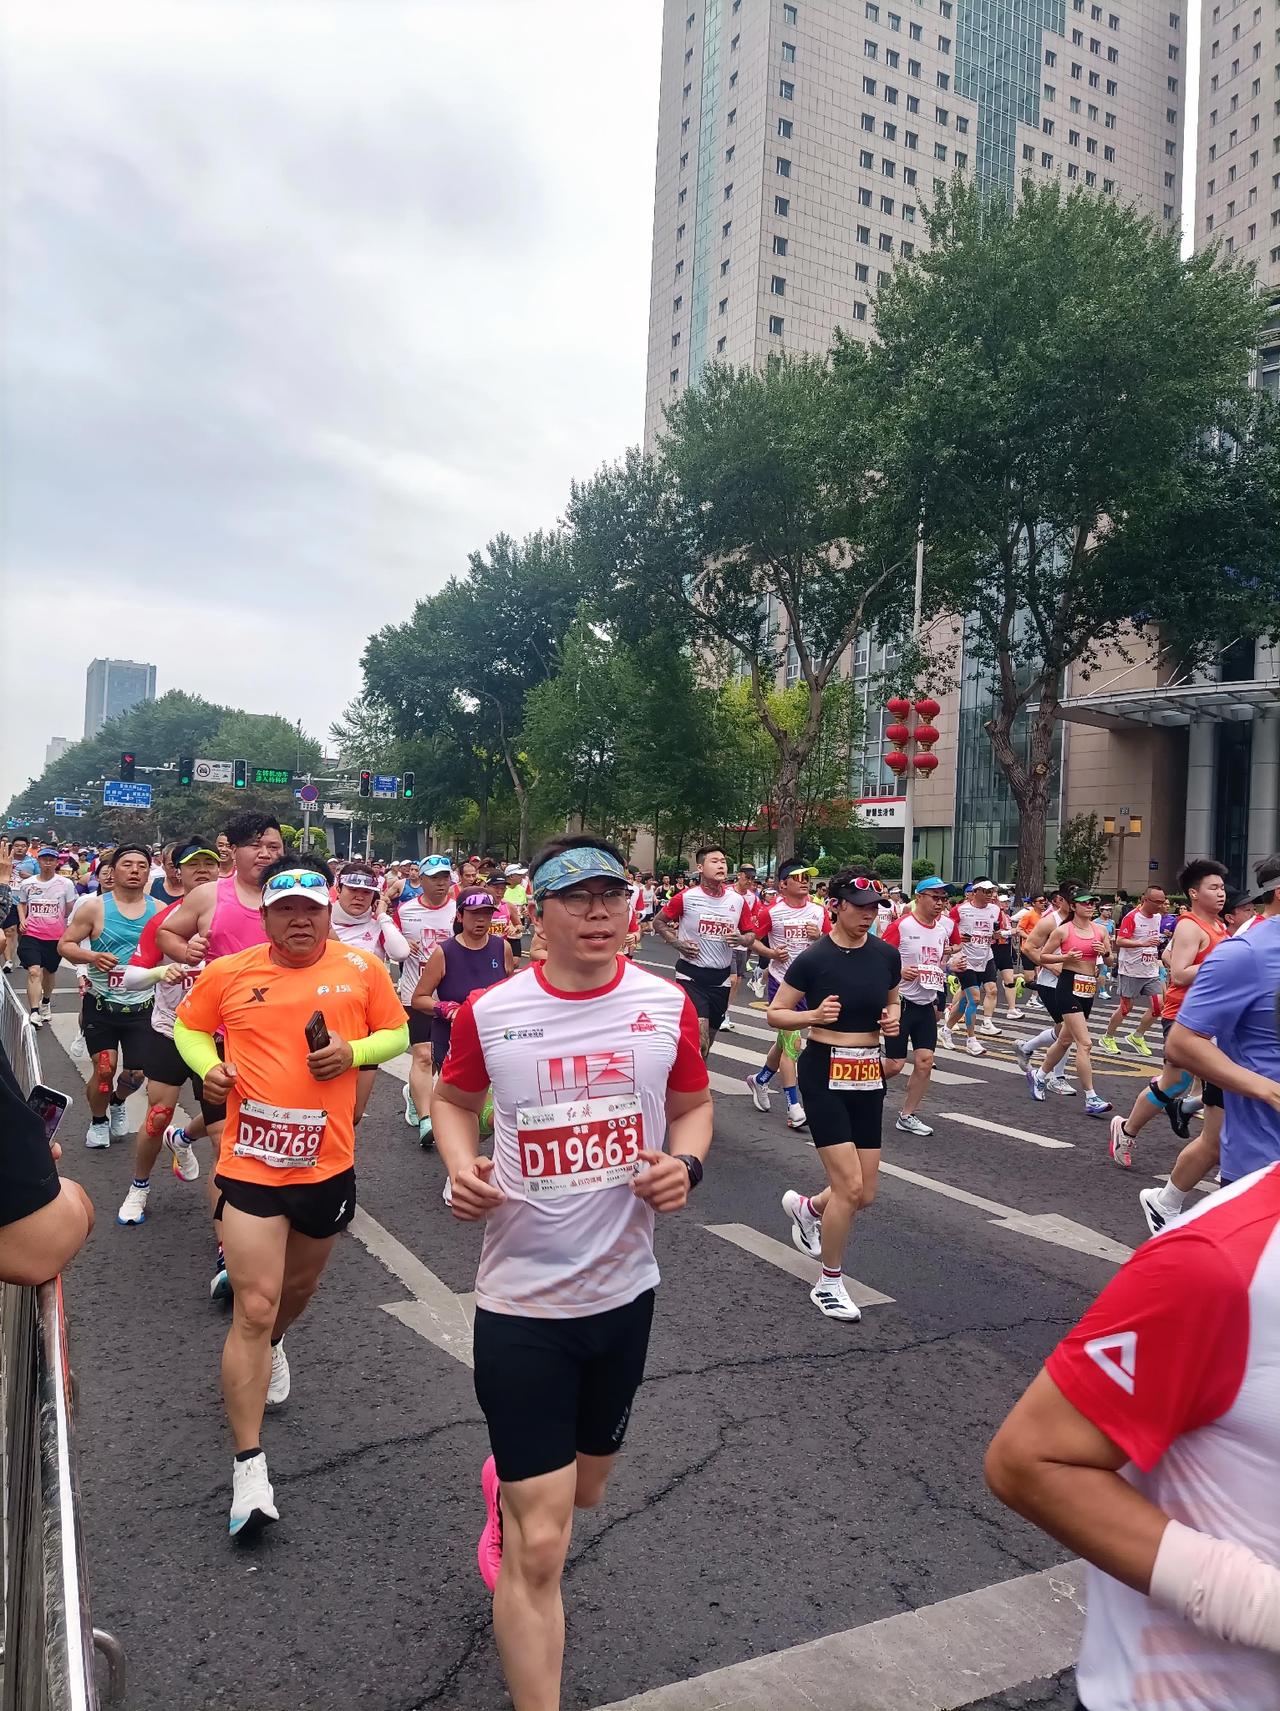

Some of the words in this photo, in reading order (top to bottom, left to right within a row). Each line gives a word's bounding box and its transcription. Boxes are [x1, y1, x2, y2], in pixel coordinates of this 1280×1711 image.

[832, 1063, 880, 1080] D21503
[240, 1121, 320, 1157] D20769
[524, 1127, 639, 1176] D19663
